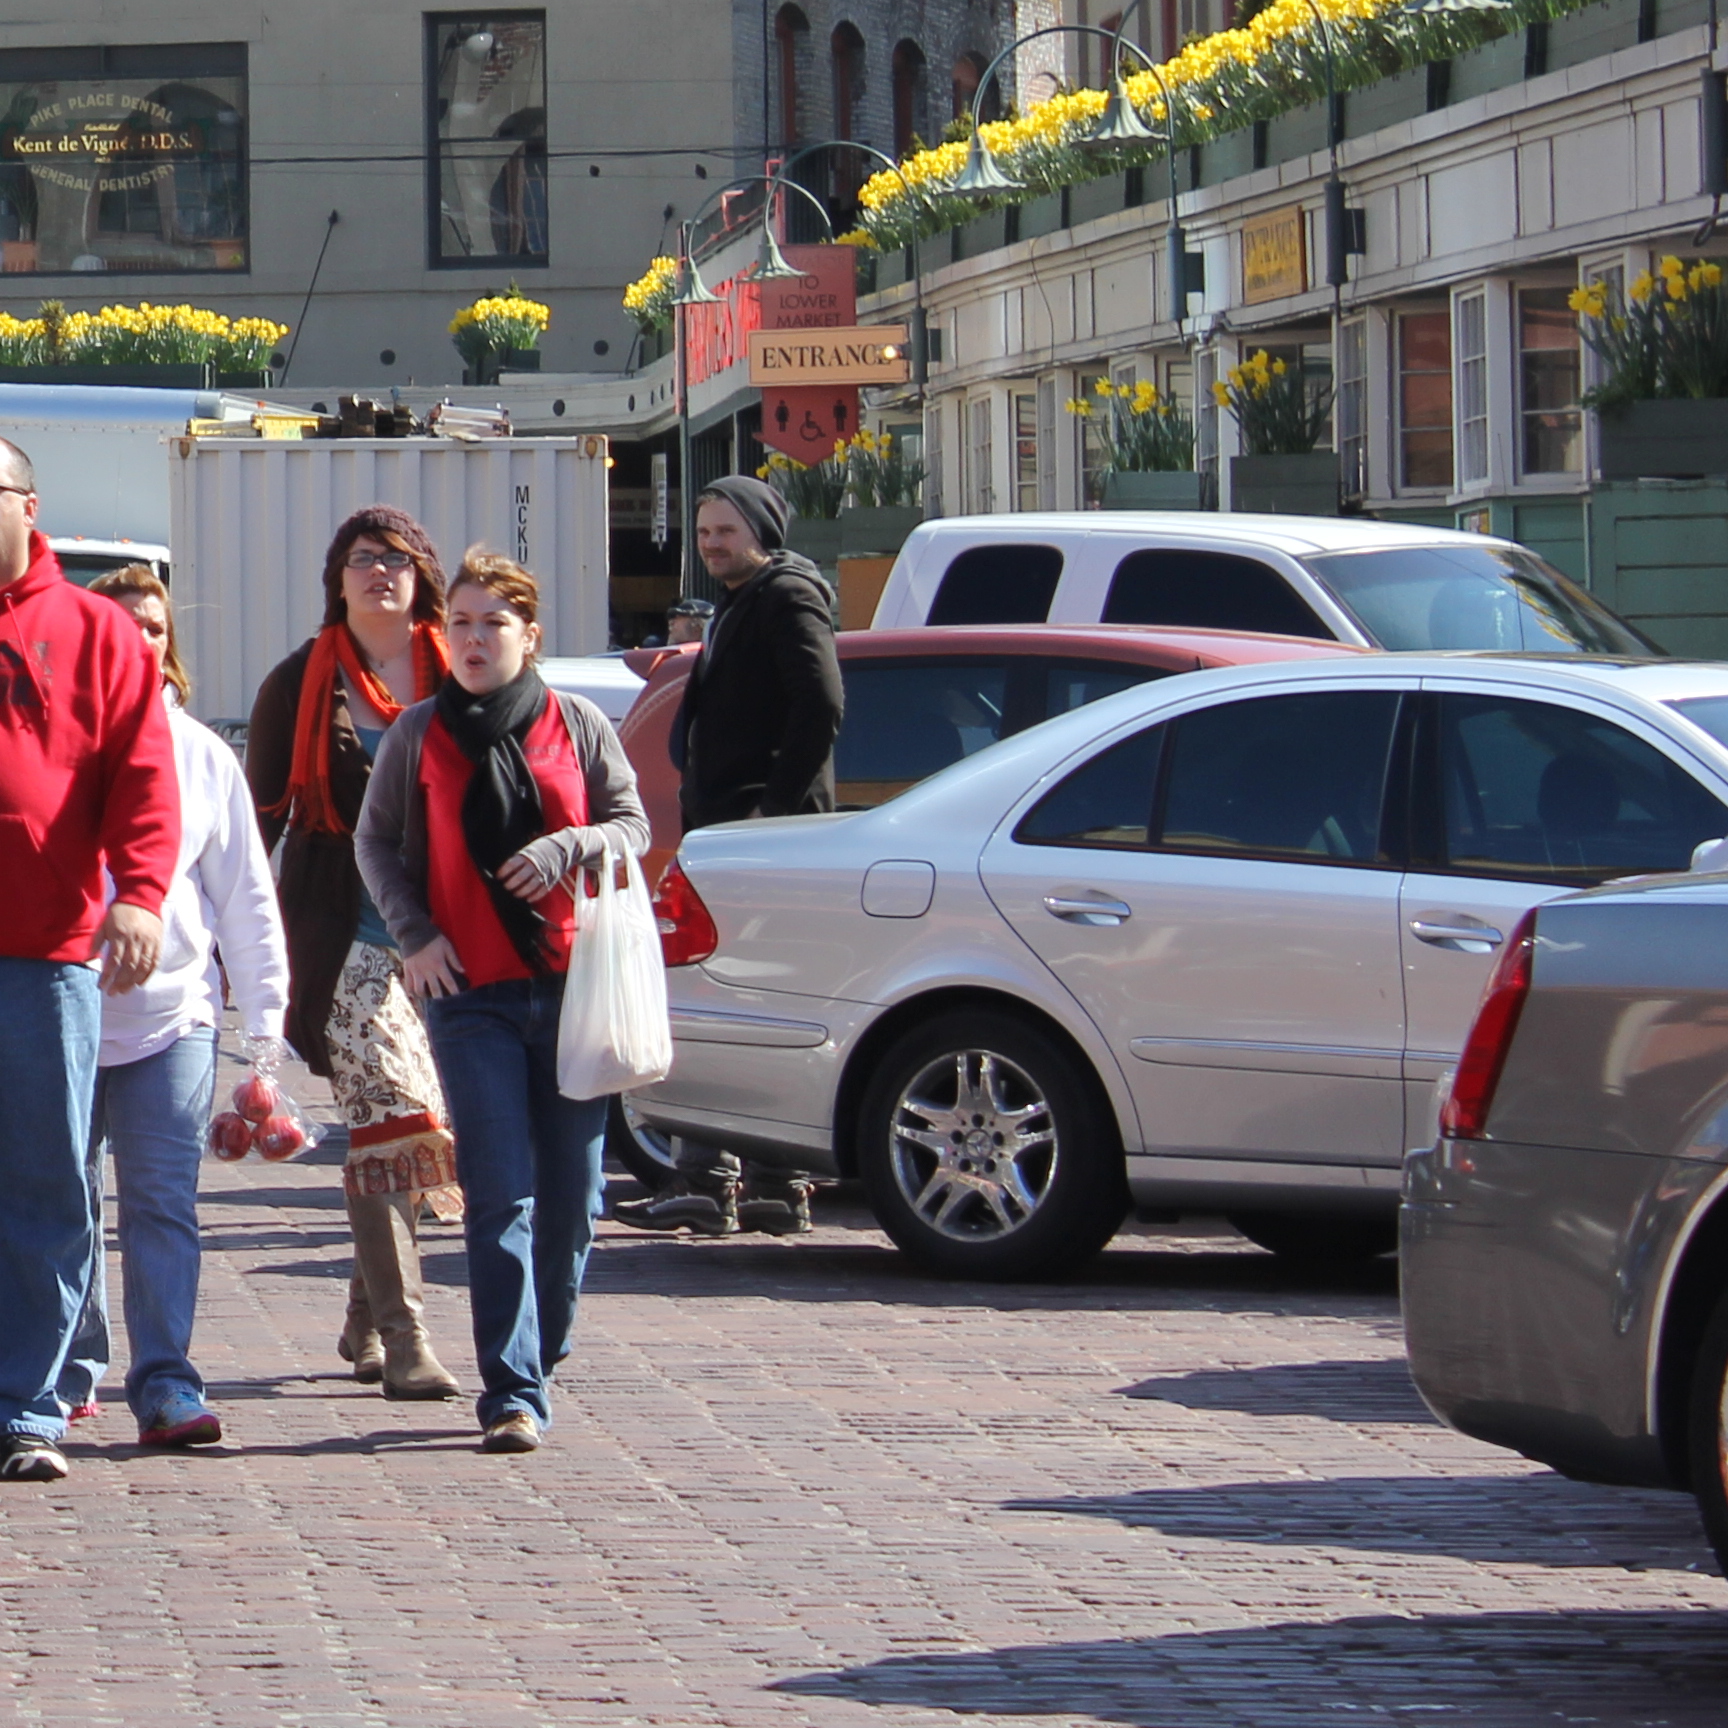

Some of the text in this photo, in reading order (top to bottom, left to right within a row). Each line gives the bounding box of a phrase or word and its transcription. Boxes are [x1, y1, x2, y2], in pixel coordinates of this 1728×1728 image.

[30, 93, 174, 127] PIKE PLACE DENTAL
[13, 135, 53, 153] Kent
[58, 134, 79, 152] de
[141, 132, 193, 151] D.D.S.
[30, 164, 175, 192] GENERAL DENTISTRY
[797, 274, 820, 290] TO
[779, 293, 838, 309] LOWER
[775, 313, 842, 328] MARKET
[515, 485, 529, 565] MCKU
